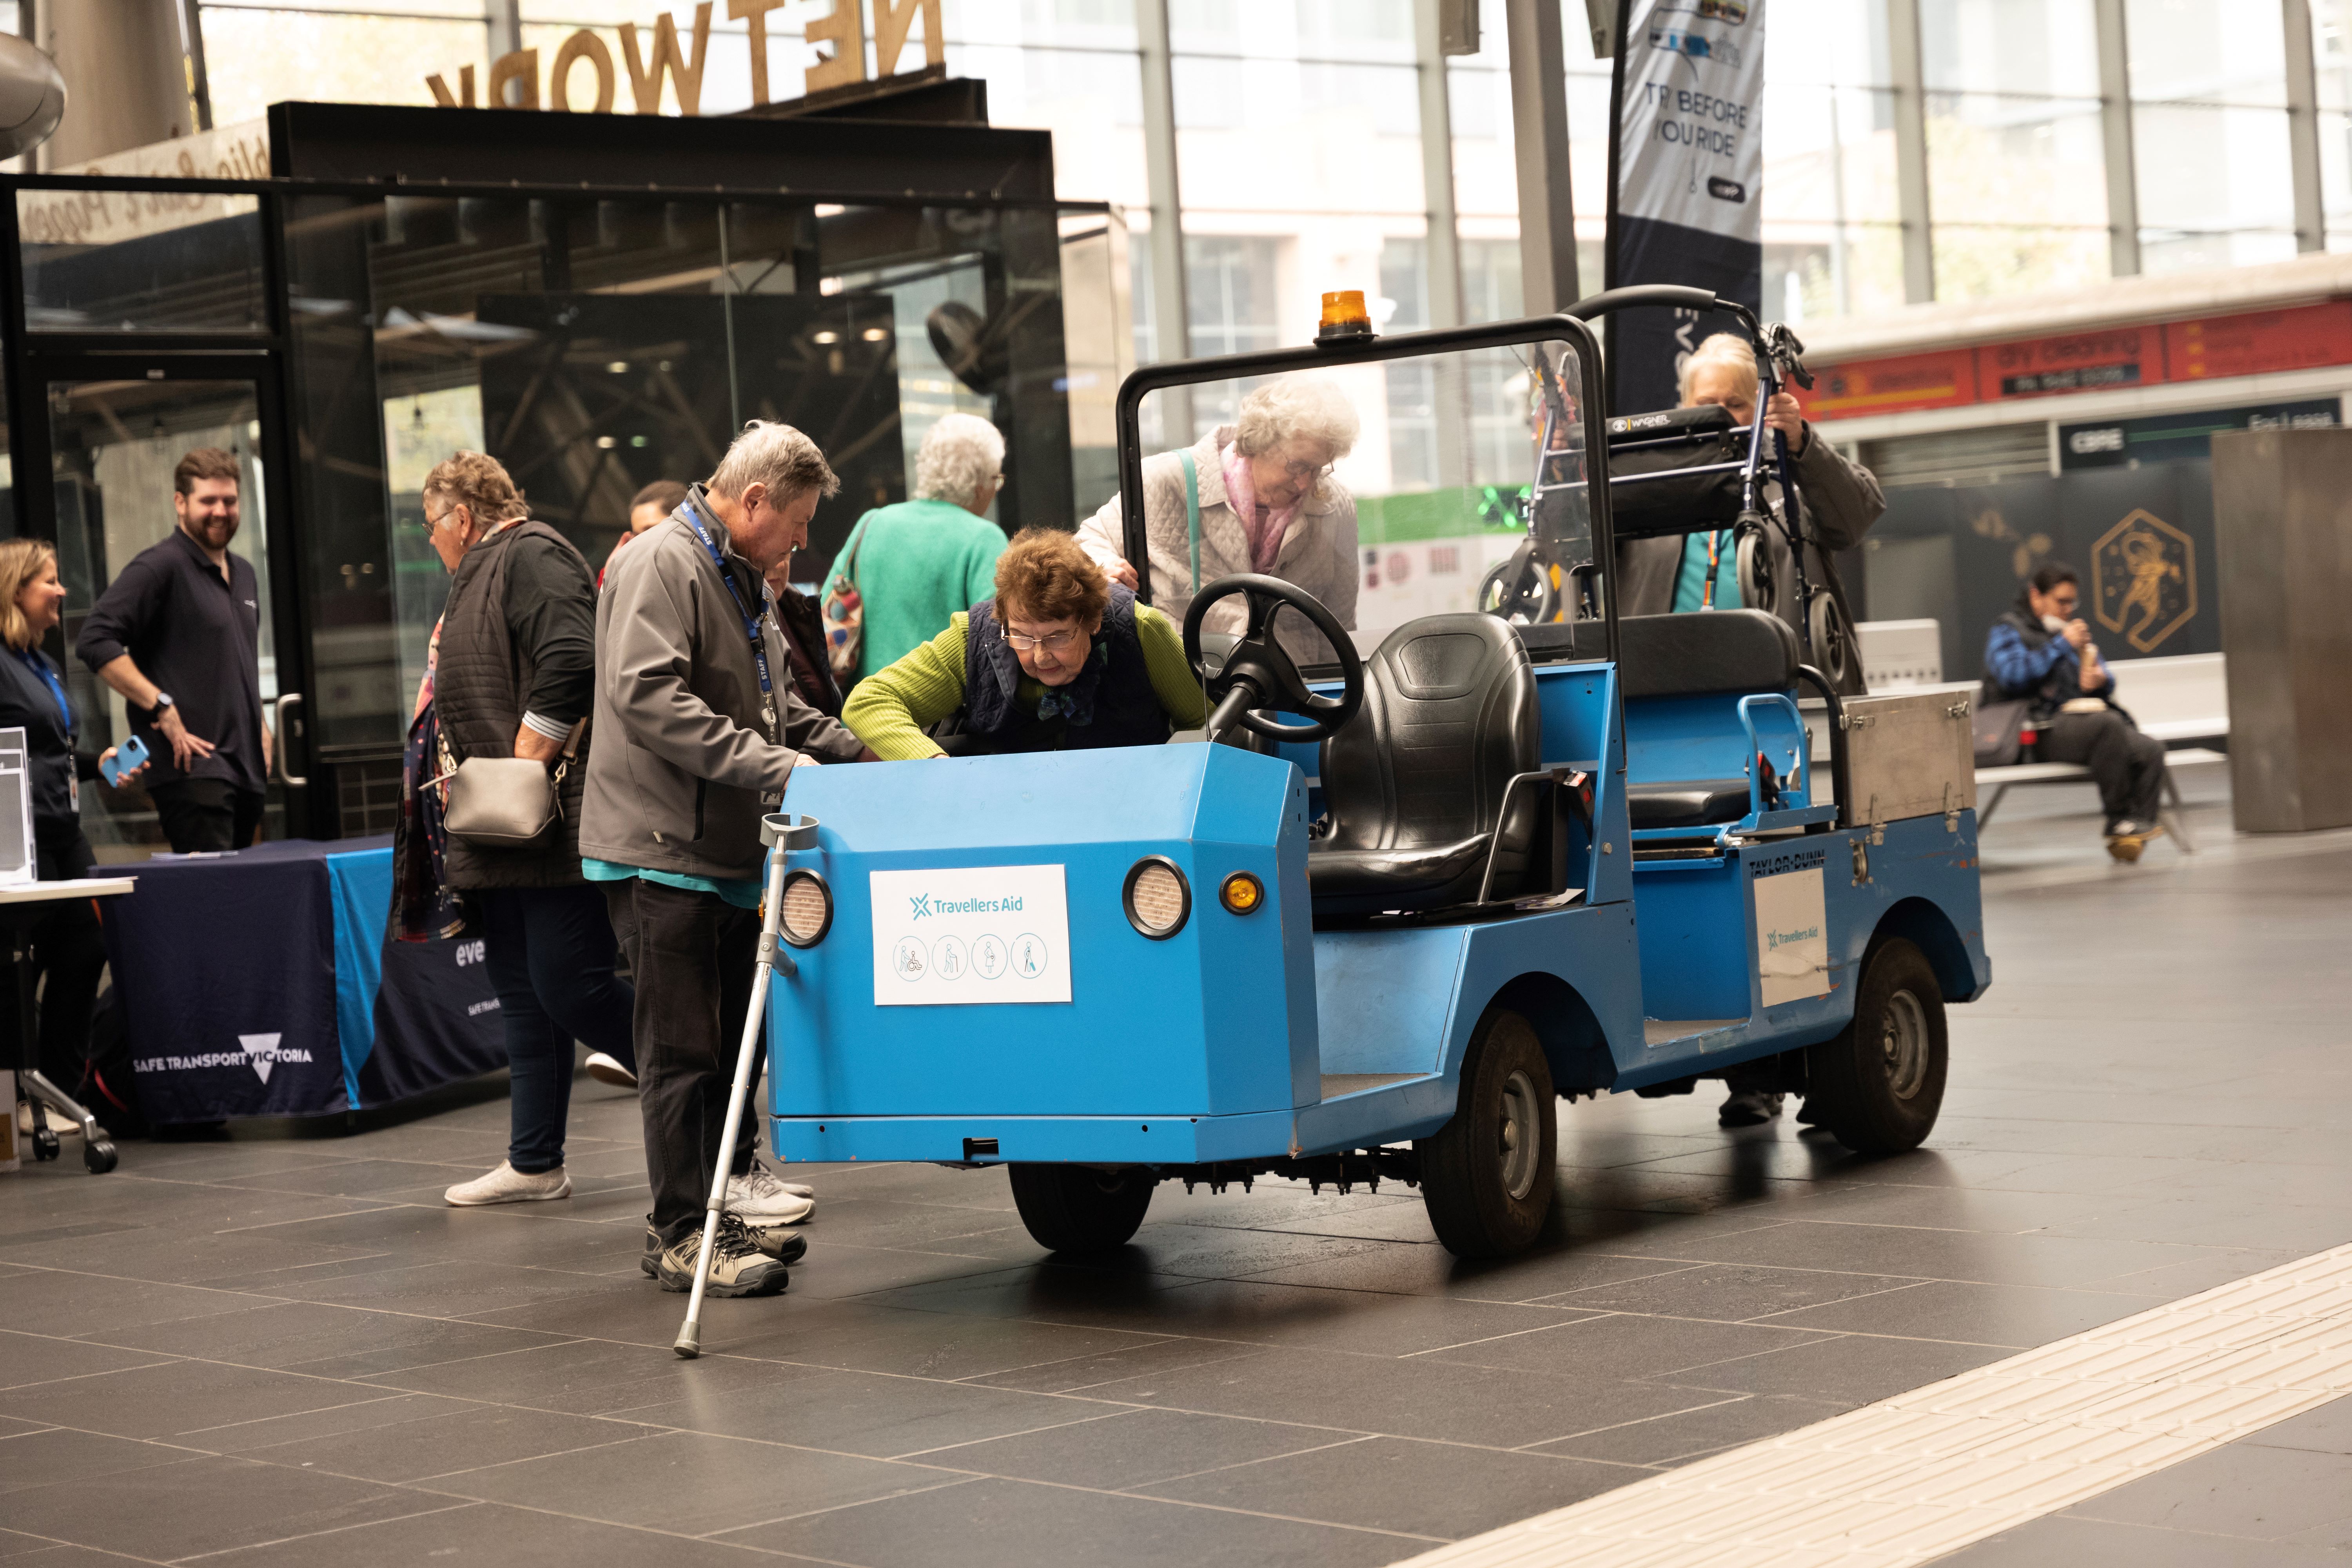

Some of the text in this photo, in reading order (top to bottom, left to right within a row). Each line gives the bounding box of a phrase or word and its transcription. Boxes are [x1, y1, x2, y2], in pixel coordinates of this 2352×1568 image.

[1677, 90, 1747, 129] BEFORE
[1696, 125, 1735, 157] RIDE
[698, 526, 712, 545] STAFF
[758, 659, 767, 680] STAFF
[934, 896, 1023, 913] Travellers Aid
[1779, 926, 1818, 944] Travellers Aid
[133, 1048, 313, 1073] SAFE TRANSPORT VICTORIA
